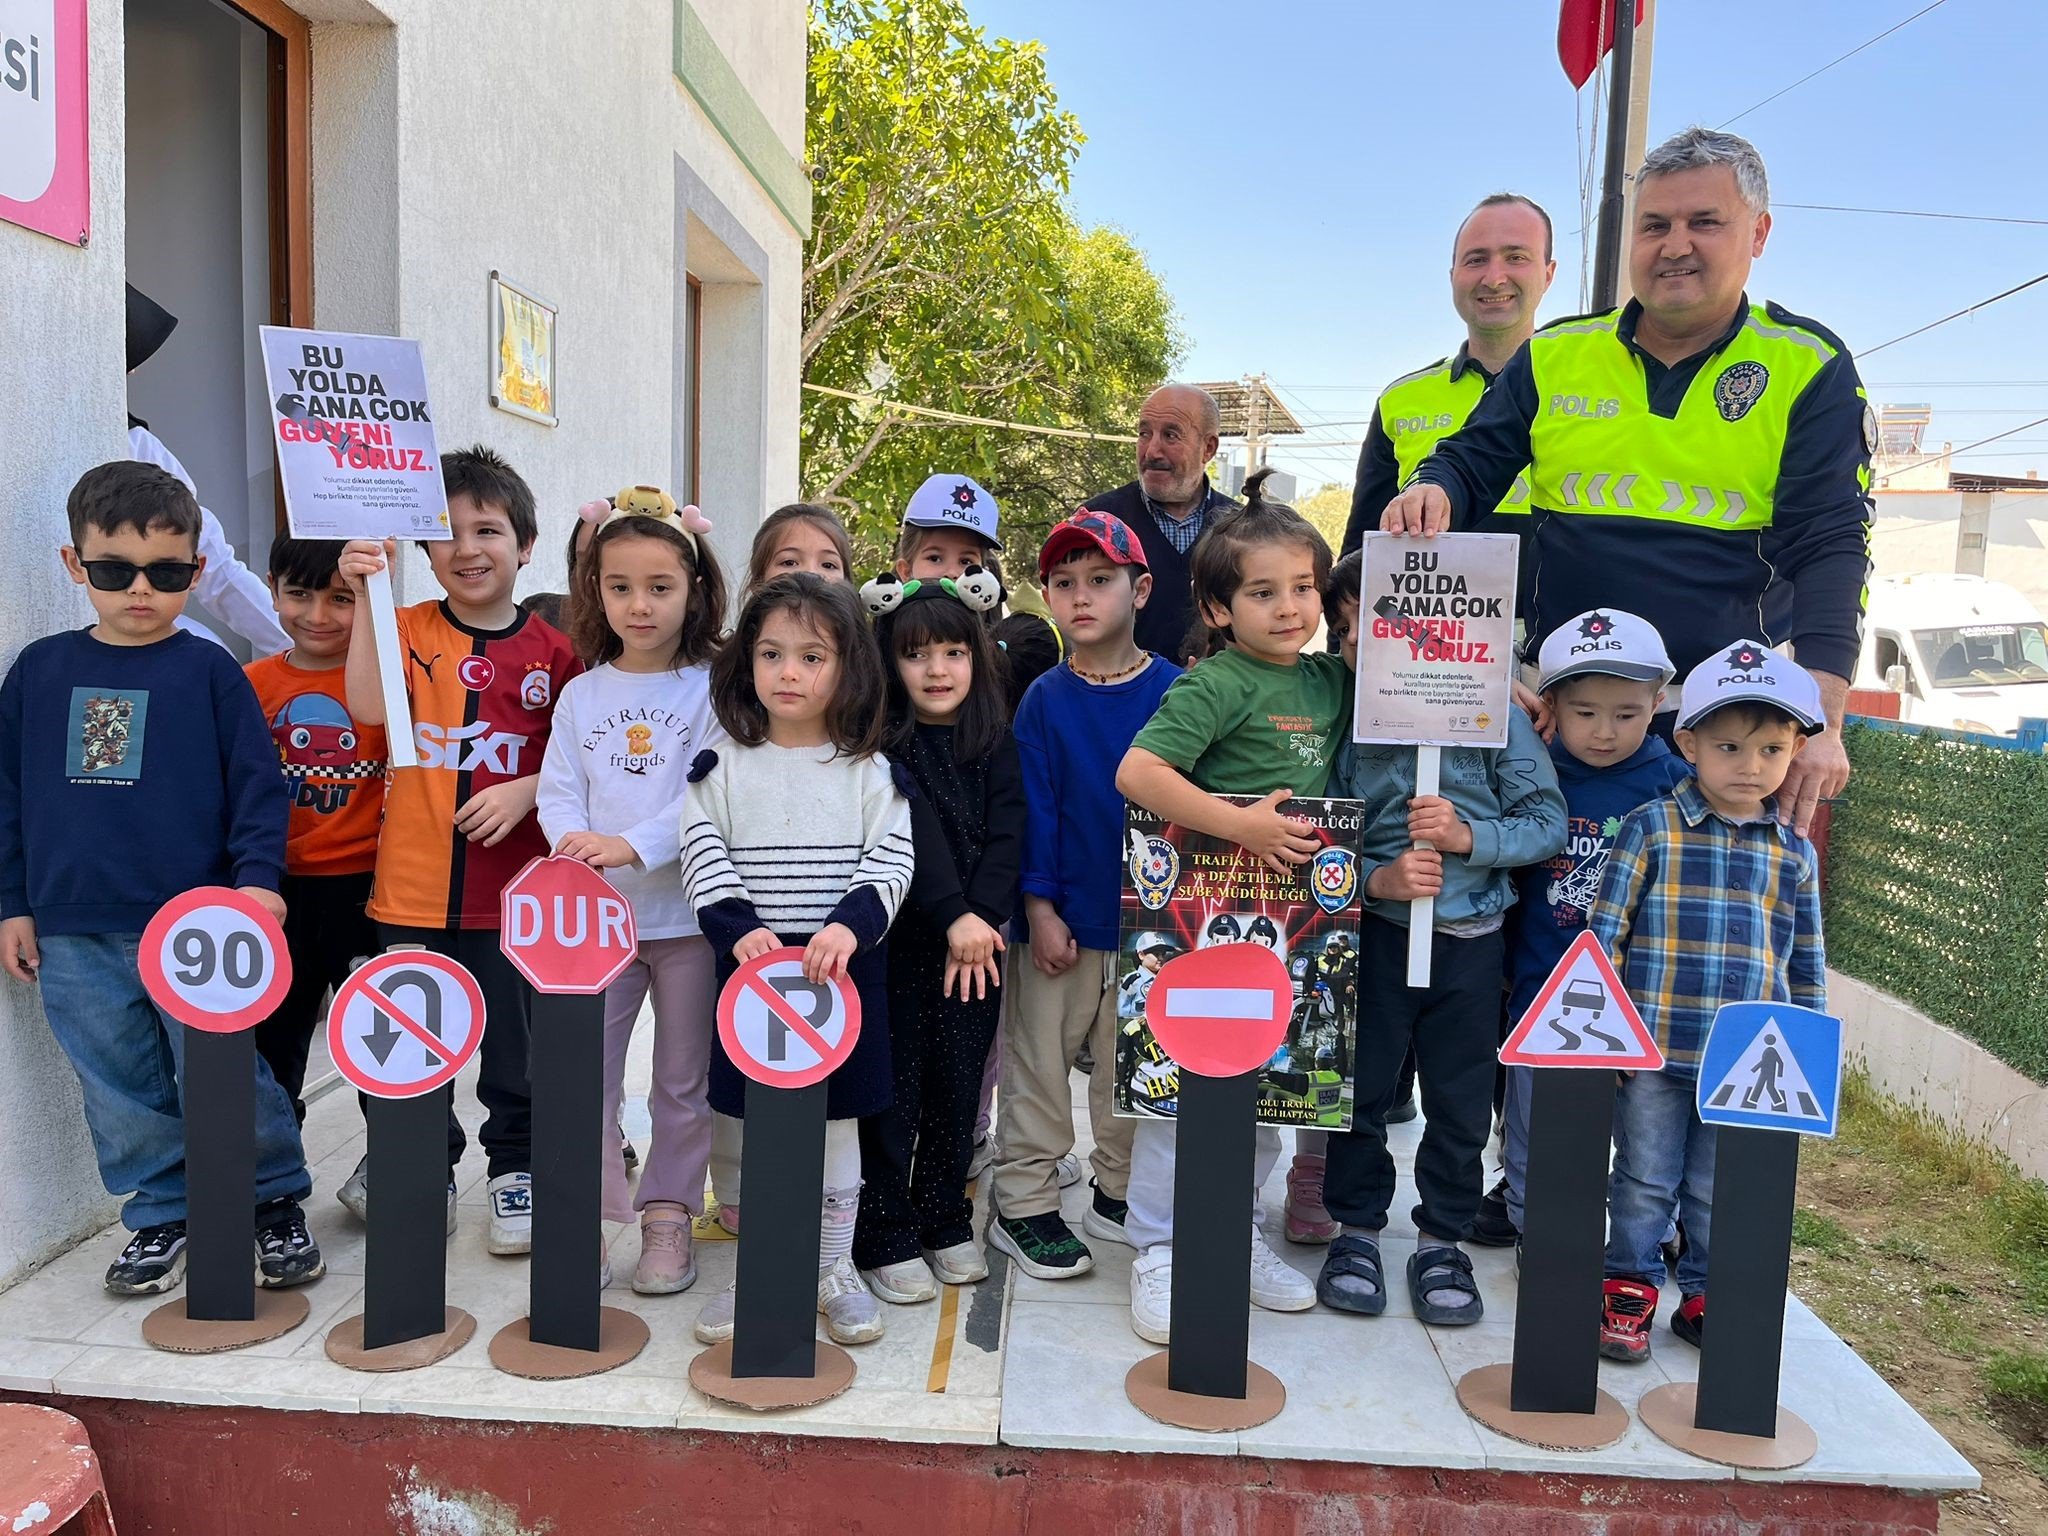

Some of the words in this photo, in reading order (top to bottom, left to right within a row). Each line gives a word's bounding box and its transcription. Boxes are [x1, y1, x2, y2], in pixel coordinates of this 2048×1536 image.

[302, 345, 344, 369] BU
[288, 368, 387, 397] YOLDA
[369, 398, 431, 423] ÇOK
[352, 477, 373, 485] dikkat
[1404, 551, 1438, 572] BU
[1390, 573, 1468, 595] YOLDA
[1450, 597, 1503, 618] ÇOK
[1392, 671, 1419, 679] Yolumuz
[1420, 672, 1440, 680] dikkat
[1379, 688, 1393, 696] Hep
[583, 707, 691, 752] EXTRACUTE
[610, 753, 666, 767] friends
[1192, 854, 1245, 867] TRAFİK
[1192, 871, 1206, 881] ve
[1208, 871, 1296, 886] DENETLEME
[1178, 885, 1214, 899] ŞUBE
[1217, 886, 1309, 902] MÜDÜRLÜĞÜ
[510, 893, 632, 948] DUR
[173, 929, 265, 989] 90
[767, 975, 834, 1062] P
[1280, 1110, 1317, 1119] HAFTASI
[1281, 1100, 1315, 1109] TRAFİK
